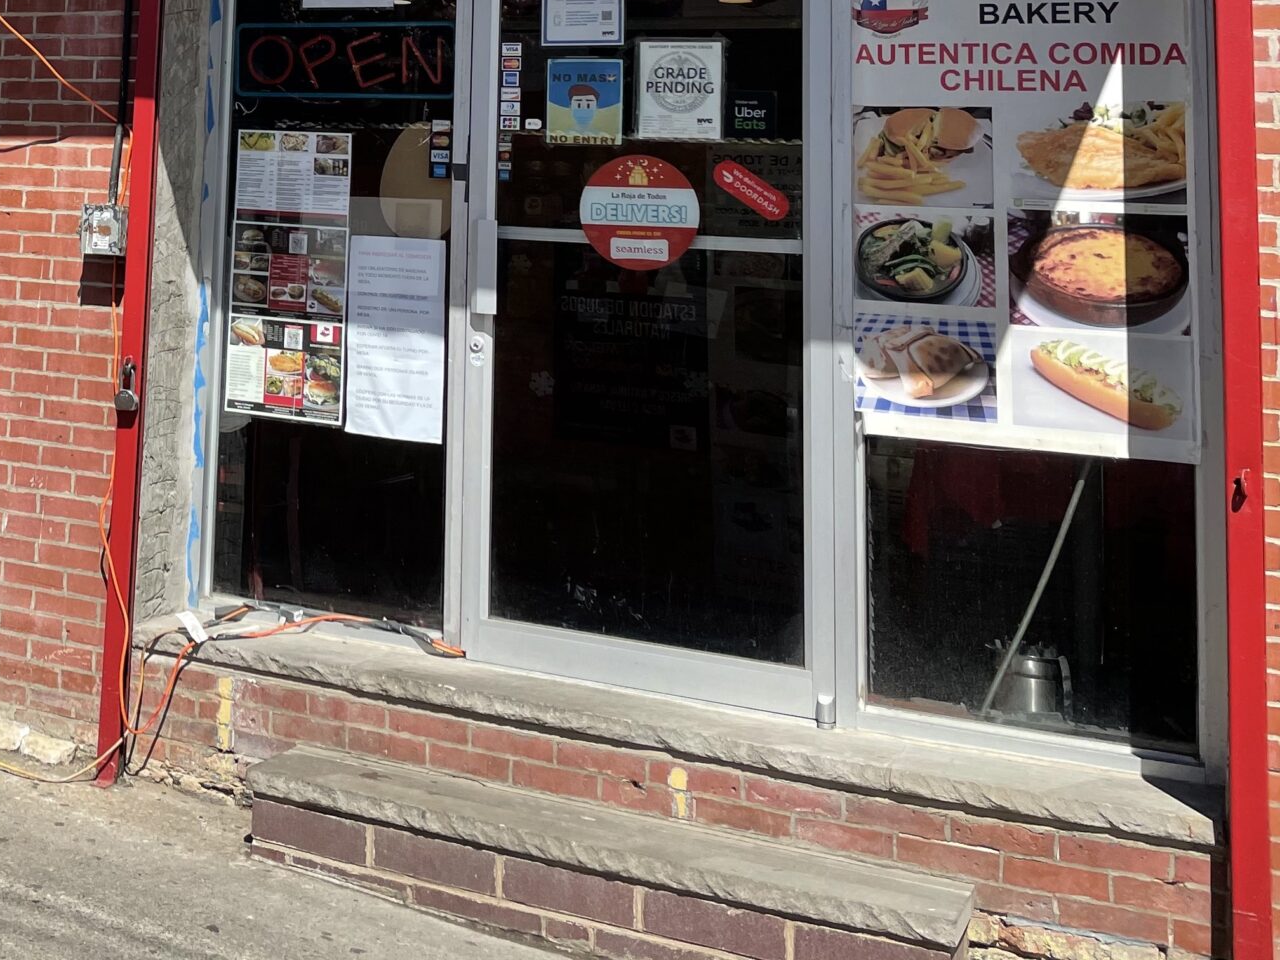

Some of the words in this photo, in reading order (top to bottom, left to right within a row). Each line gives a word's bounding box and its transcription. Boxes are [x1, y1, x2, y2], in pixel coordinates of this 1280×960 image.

[979, 1, 1120, 25] BAKERY
[247, 32, 443, 88] OPEN
[855, 42, 1038, 65] AUTENTICA
[1048, 42, 1187, 65] COMIDA
[552, 74, 571, 82] NO
[576, 73, 617, 83] MASK
[654, 67, 707, 79] GRADE
[940, 69, 1088, 92] CHILENA
[646, 81, 714, 94] PENDING
[734, 106, 766, 118] Uber
[735, 119, 766, 130] Eats
[550, 135, 568, 143] NO
[573, 136, 617, 145] ENTRY
[733, 169, 743, 179] We
[743, 177, 764, 192] deliver
[763, 190, 777, 202] with
[621, 192, 636, 200] Roja
[734, 181, 780, 215] DOORDASH
[590, 202, 687, 224] DELIVERS!
[615, 245, 664, 255] seamless
